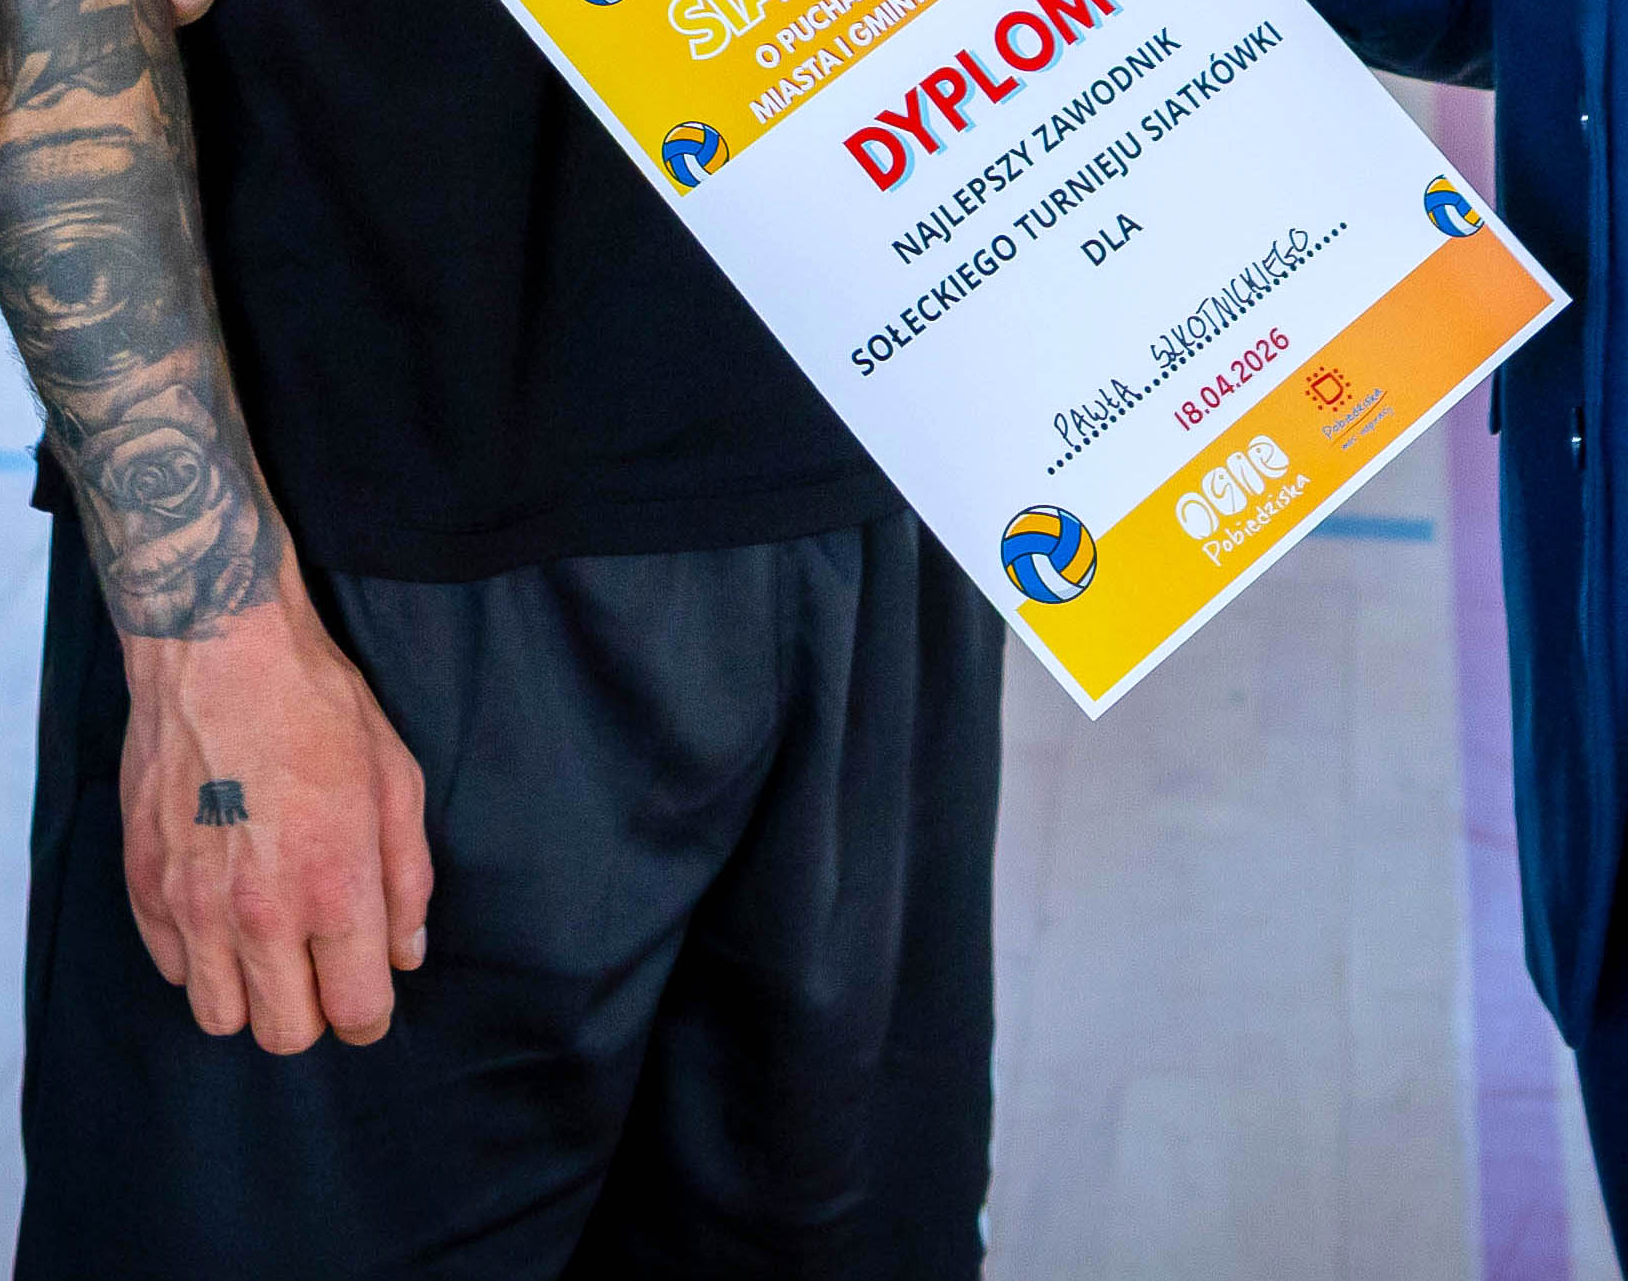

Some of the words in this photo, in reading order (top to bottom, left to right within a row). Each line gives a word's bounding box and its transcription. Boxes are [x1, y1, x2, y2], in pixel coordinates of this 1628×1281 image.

[749, 48, 845, 125] MIASTA
[834, 35, 854, 58] I
[755, 42, 782, 69] O
[891, 139, 1036, 265] NAJLEPSZY
[1031, 27, 1183, 153] ZAWODNIK
[850, 234, 1018, 377] SOŁECKIEGO
[1013, 130, 1144, 240] TURNIEJU
[1140, 20, 1284, 142] SIATKÓWKI
[1079, 212, 1145, 267] DLA
[1173, 327, 1290, 431] 18.04.2026
[1201, 474, 1311, 567] Pobiedziska
